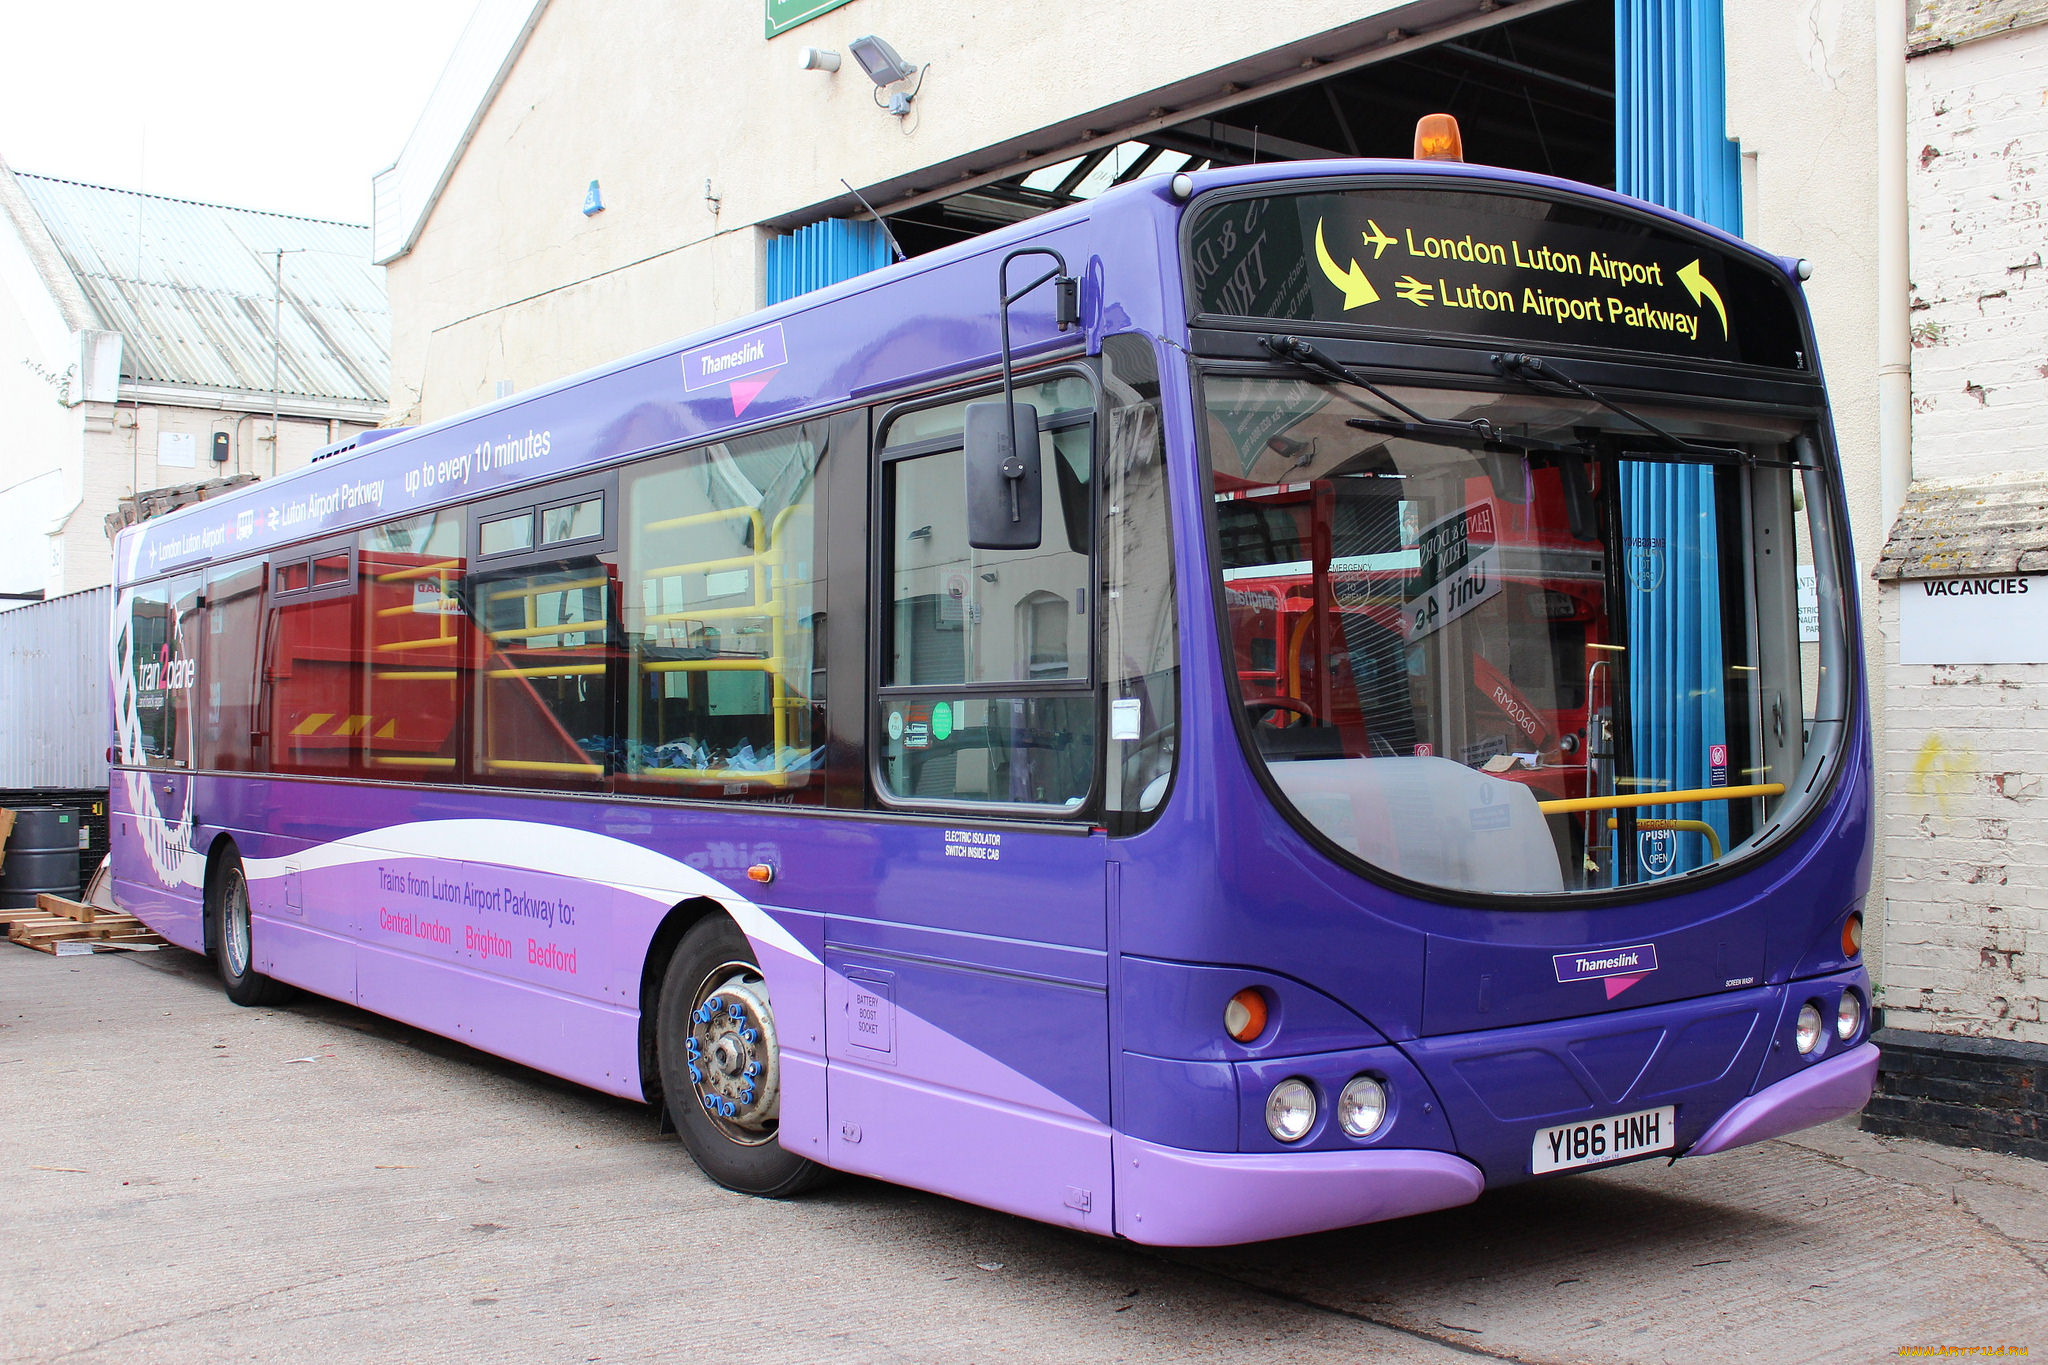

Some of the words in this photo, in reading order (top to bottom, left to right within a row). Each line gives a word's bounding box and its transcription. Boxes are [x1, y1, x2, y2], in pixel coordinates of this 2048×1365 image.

[1405, 228, 1507, 265] London
[1512, 240, 1582, 275] Luton
[1589, 251, 1663, 287] Airport
[1439, 278, 1515, 312] Luton
[1522, 287, 1603, 324] Airport
[1607, 297, 1698, 340] Parkway
[701, 339, 765, 376] Thameslink
[405, 469, 420, 497] up
[422, 461, 435, 487] to
[438, 453, 472, 485] every
[475, 441, 491, 472] 10
[494, 429, 551, 468] minutes
[282, 502, 306, 526] Luton
[308, 493, 339, 523] Airport
[341, 479, 385, 508] Parkway
[159, 538, 181, 561] London
[182, 533, 201, 554] Luton
[202, 524, 225, 552] Airport
[1923, 578, 2028, 596] VACANCIES
[1493, 686, 1536, 734] RM2060
[945, 830, 972, 843] ELECTRIC
[972, 832, 1001, 846] ISOLATOR
[1645, 829, 1670, 841] PUSH
[1653, 841, 1663, 852] TO
[945, 844, 967, 857] SWITCH
[967, 846, 987, 859] INSIDE
[987, 848, 1000, 860] CAB
[1649, 852, 1668, 864] OPEN
[379, 867, 406, 893] Trains
[407, 871, 430, 897] from
[432, 876, 461, 904] Luton
[463, 881, 501, 913] Airport
[504, 888, 555, 928] Parkway
[558, 898, 575, 926] to:
[379, 906, 412, 935] Central
[414, 914, 451, 945] London
[465, 925, 512, 959] Brighton
[528, 938, 577, 974] Bedford
[1575, 952, 1639, 973] Thameslink
[857, 994, 878, 1007] BATTERY
[860, 1008, 877, 1020] BOOST
[858, 1021, 878, 1034] SOCKET
[1549, 1123, 1606, 1163] Y186
[1614, 1112, 1660, 1152] HNH
